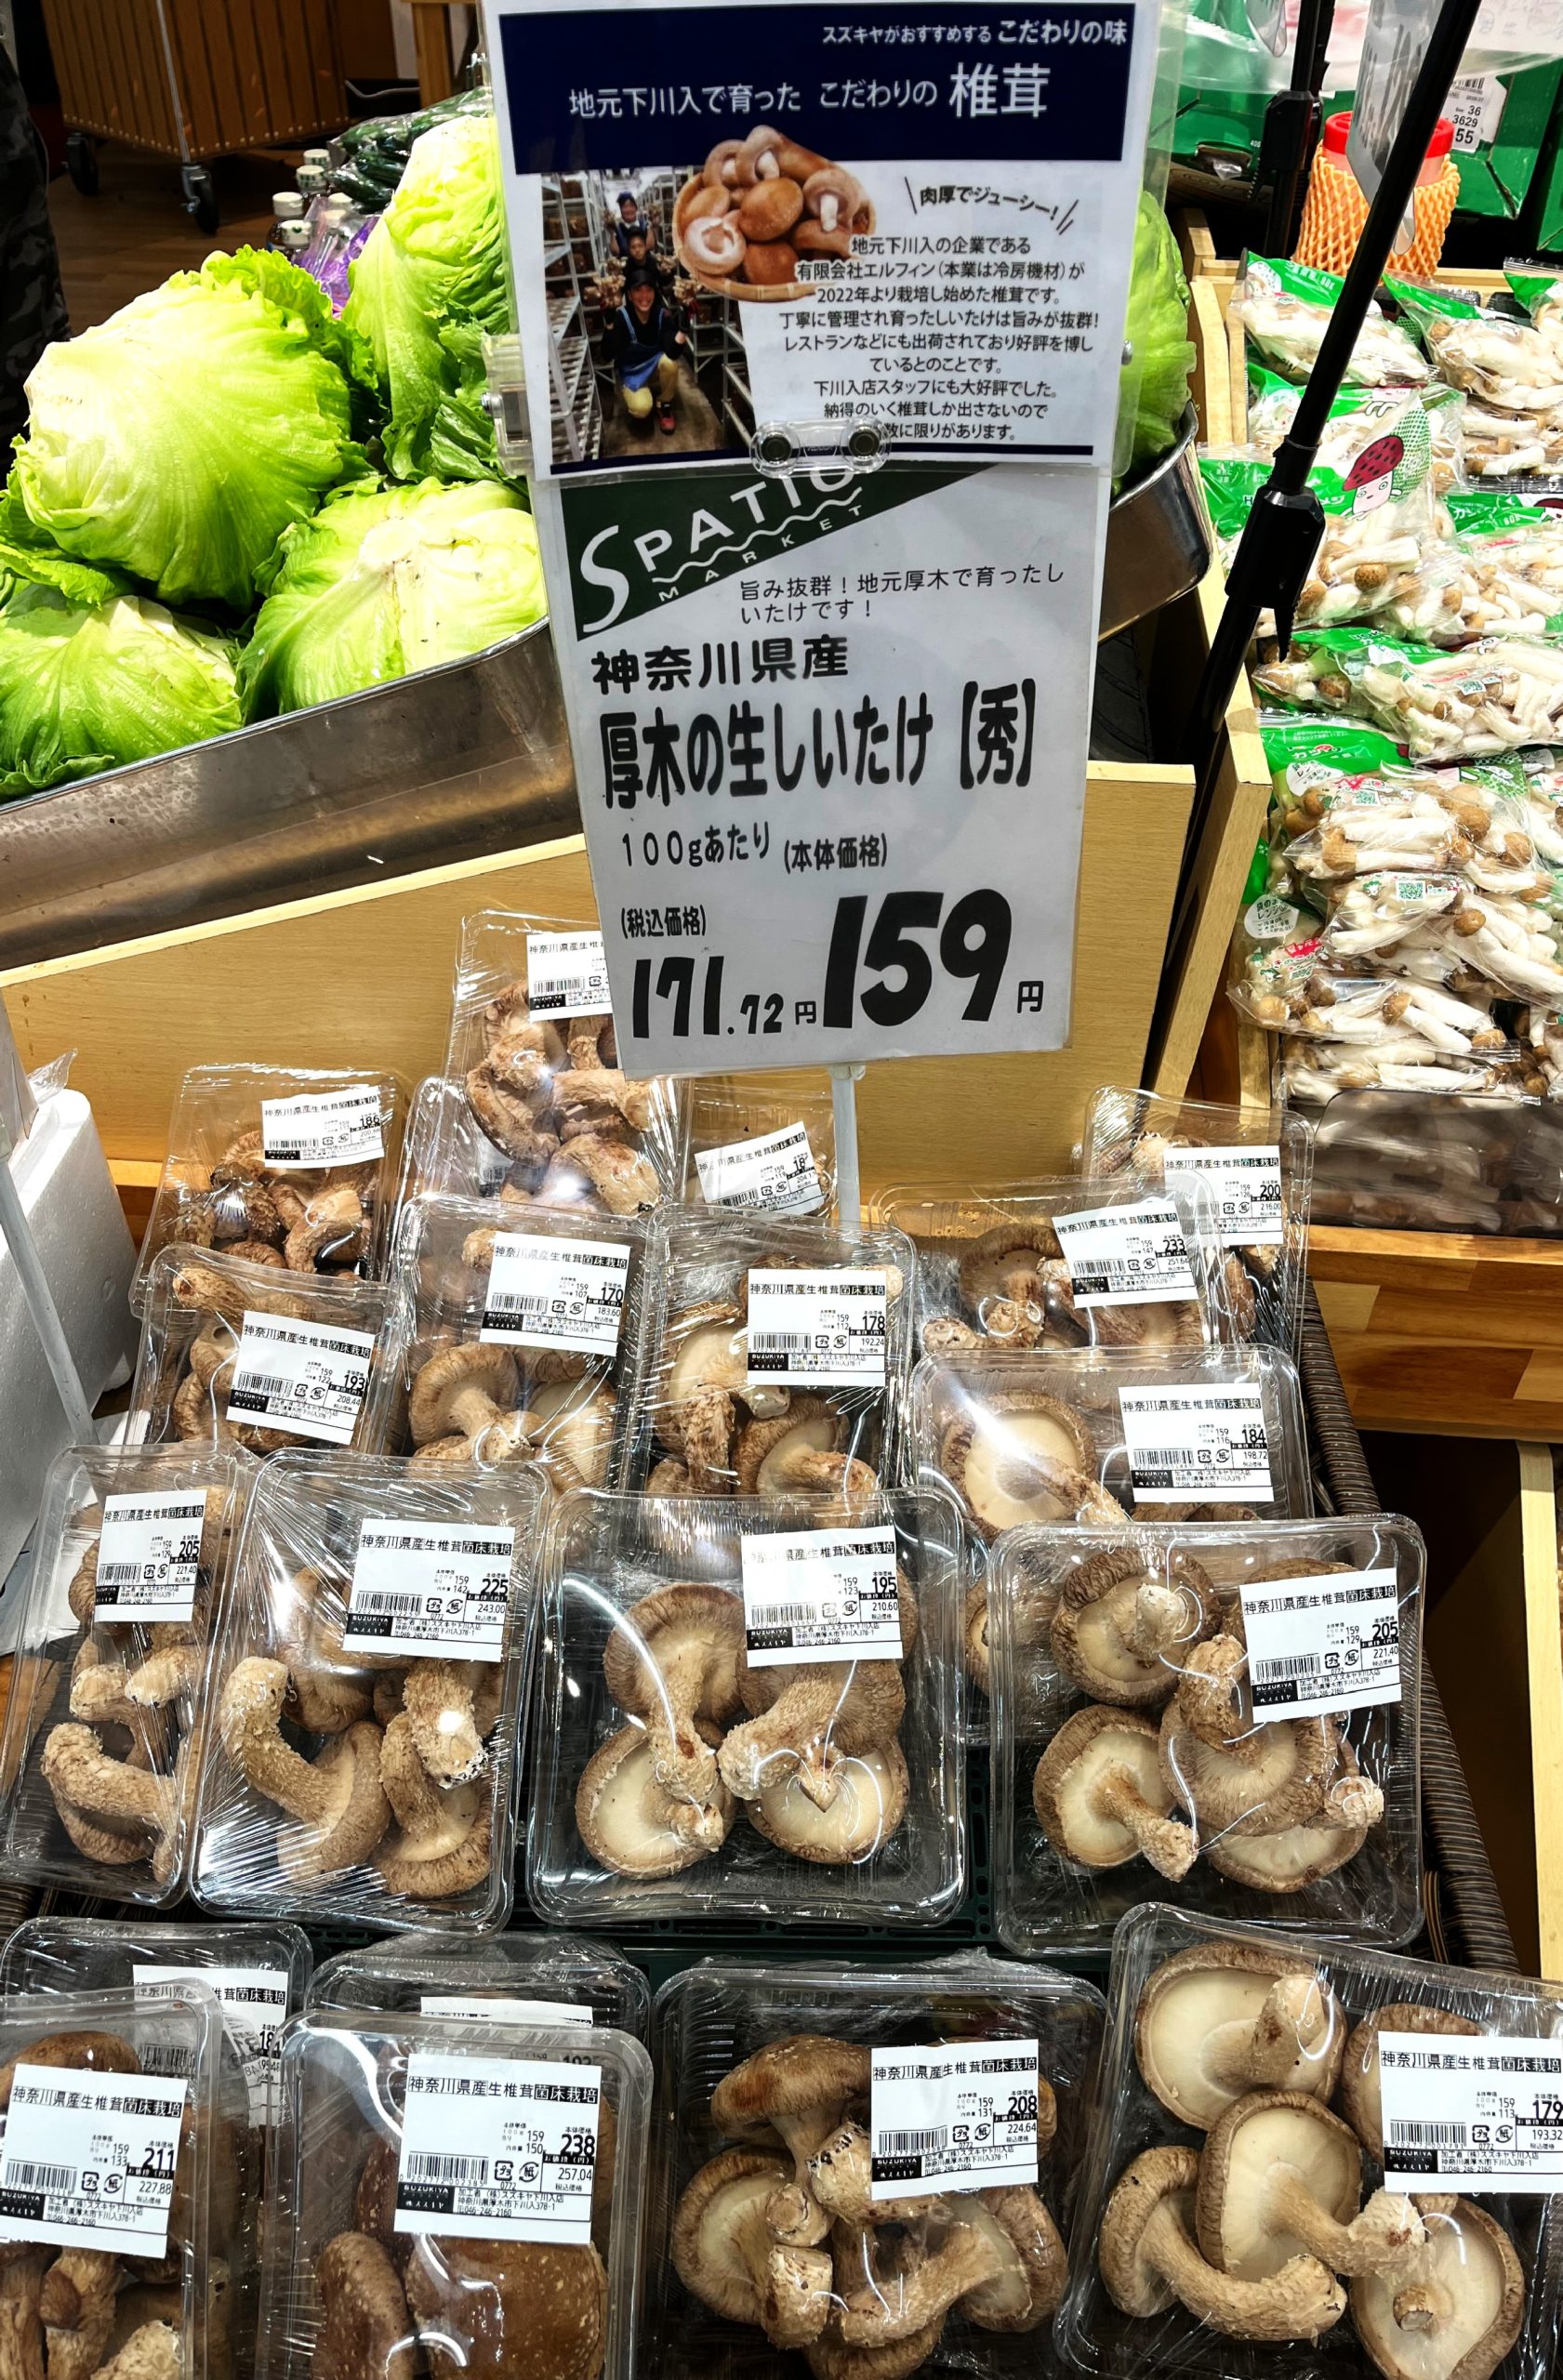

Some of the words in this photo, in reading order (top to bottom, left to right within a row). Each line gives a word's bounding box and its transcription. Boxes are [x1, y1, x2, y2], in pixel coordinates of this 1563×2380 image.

[822, 25, 992, 45] スズキヤがおすすめする
[997, 20, 1127, 45] こだわりの味
[568, 83, 801, 117] 地元下川入で育った
[819, 82, 937, 109] こだわりの
[948, 60, 1052, 117] 椎茸
[1468, 105, 1481, 116] 36
[1452, 114, 1478, 128] 3629
[1455, 128, 1474, 144] 55
[920, 185, 1059, 221] 肉厚でジューシー!
[852, 236, 1031, 255] 地元下川入の企業である
[817, 286, 1060, 304] 2022年より栽培し始めた椎茸です。
[779, 310, 1099, 329] 丁寧に管理され育ったしいたけは旨みが抜群!
[785, 334, 1093, 352] レストランなどにも出荷されており好評を博し
[869, 356, 1001, 374] ているとのことです。
[815, 379, 1057, 398] 下川入店スタッフにも大好評でした。
[824, 402, 1048, 419] 納得のいく椎茸しか出さないので
[878, 423, 1015, 441] 数に限りがあります。
[656, 504, 863, 602] MARKET
[740, 566, 1065, 600] 旨み抜群！地元厚木で育ったし
[741, 599, 872, 625] いたけです！
[591, 634, 849, 695] 神奈川県産
[600, 693, 934, 809] 厚木の生しいたけ
[959, 678, 1037, 790] 【秀】
[622, 822, 770, 867] 100gあたり
[783, 833, 888, 874] (本体価格)
[621, 906, 707, 940] (税込価格)
[529, 941, 603, 954] 神奈川県産生椎
[823, 888, 1013, 1028] 159
[1018, 980, 1044, 1013] 円
[795, 1000, 817, 1025] 円
[360, 1115, 379, 1127] 186
[1260, 1184, 1280, 1197] 200
[1163, 1239, 1186, 1252] 233
[601, 1287, 623, 1302] 170
[597, 1306, 621, 1317] 183.60
[837, 1314, 850, 1322] 159
[862, 1316, 885, 1331] 178
[861, 1338, 884, 1346] 192.24
[321, 1368, 333, 1376] 159
[344, 1374, 365, 1391] 193
[337, 1394, 361, 1406] 208.44
[1215, 1428, 1229, 1436] 159
[1241, 1428, 1265, 1444] 184
[1243, 1451, 1268, 1460] 198.72
[163, 1540, 172, 1550] 159
[179, 1540, 200, 1558] 205
[177, 1566, 197, 1575] 221.40
[455, 1575, 470, 1584] 159
[843, 1578, 857, 1586] 159
[872, 1576, 897, 1594] 195
[454, 1585, 468, 1594] 142
[481, 1579, 509, 1596] 225
[844, 1587, 857, 1595] 123
[478, 1603, 506, 1613] 243.00
[872, 1601, 898, 1612] 210.60
[1346, 1625, 1359, 1635] 159
[1371, 1621, 1398, 1641] 205
[1346, 1635, 1359, 1645] 129
[1372, 1646, 1398, 1659] 221.40
[408, 2075, 599, 2105] 神奈川県産生椎茸菌床栽培
[13, 2085, 182, 2118] 神奈川県産生椎茸菌床栽培
[978, 2097, 994, 2108] 159
[1008, 2096, 1037, 2116] 208
[1499, 2097, 1515, 2108] 159
[978, 2108, 992, 2117] 131
[1499, 2109, 1515, 2119] 113
[1532, 2100, 1563, 2121] 179
[1008, 2122, 1037, 2134] 224.64
[1532, 2129, 1563, 2141] 193.32
[527, 2130, 545, 2143] 159
[113, 2143, 130, 2155] 159
[525, 2143, 543, 2154] 150
[561, 2134, 595, 2157] 238
[111, 2155, 127, 2167] 133
[143, 2147, 175, 2171] 211
[558, 2167, 592, 2182] 257.04
[139, 2181, 172, 2195] 227.88
[404, 2185, 449, 2194] SUZUKIYA
[499, 2181, 517, 2191] 0772
[2, 2191, 41, 2202] SUZUKIYA
